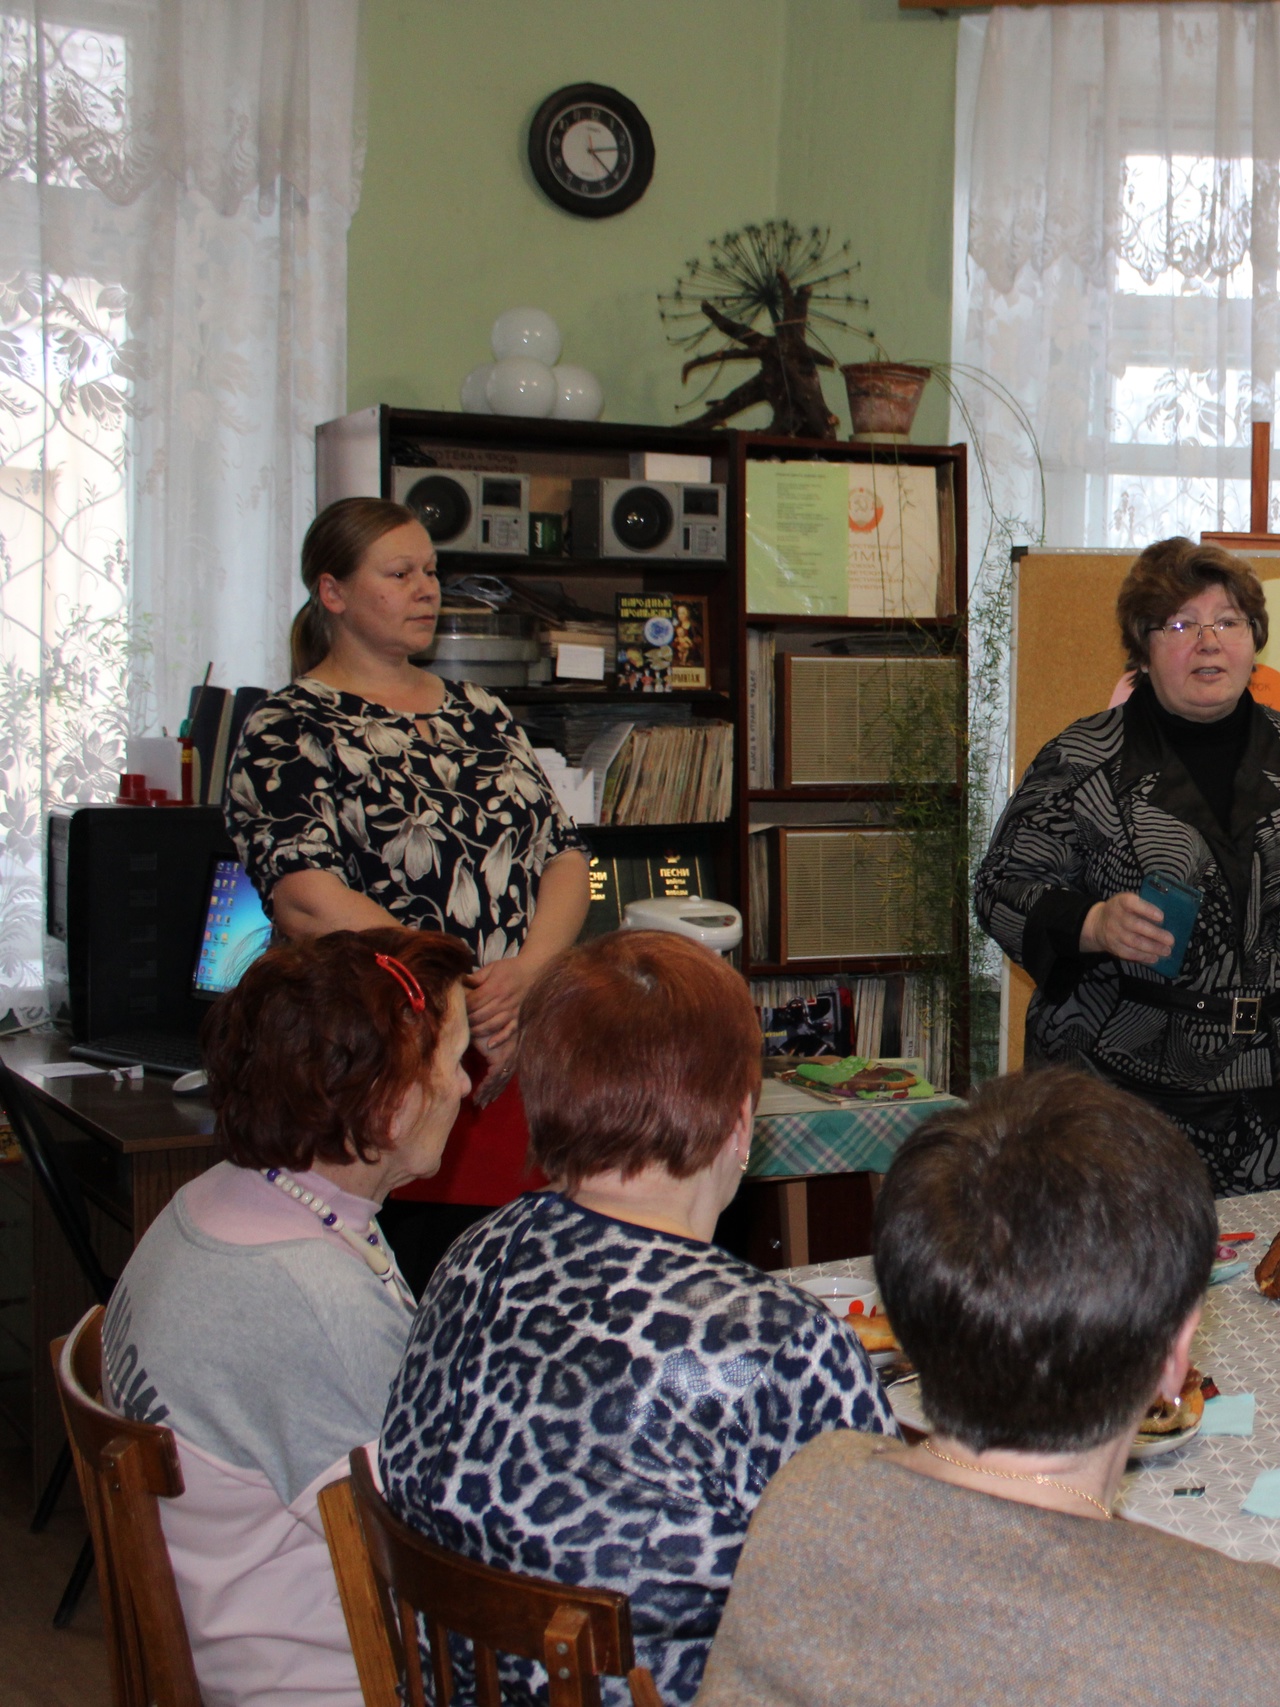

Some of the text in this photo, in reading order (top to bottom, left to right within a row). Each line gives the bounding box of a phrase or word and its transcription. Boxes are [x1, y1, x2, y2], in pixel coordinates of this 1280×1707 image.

[848, 551, 890, 562] ИМН
[589, 871, 608, 881] СНИ
[659, 868, 690, 877] ПЕСНИ
